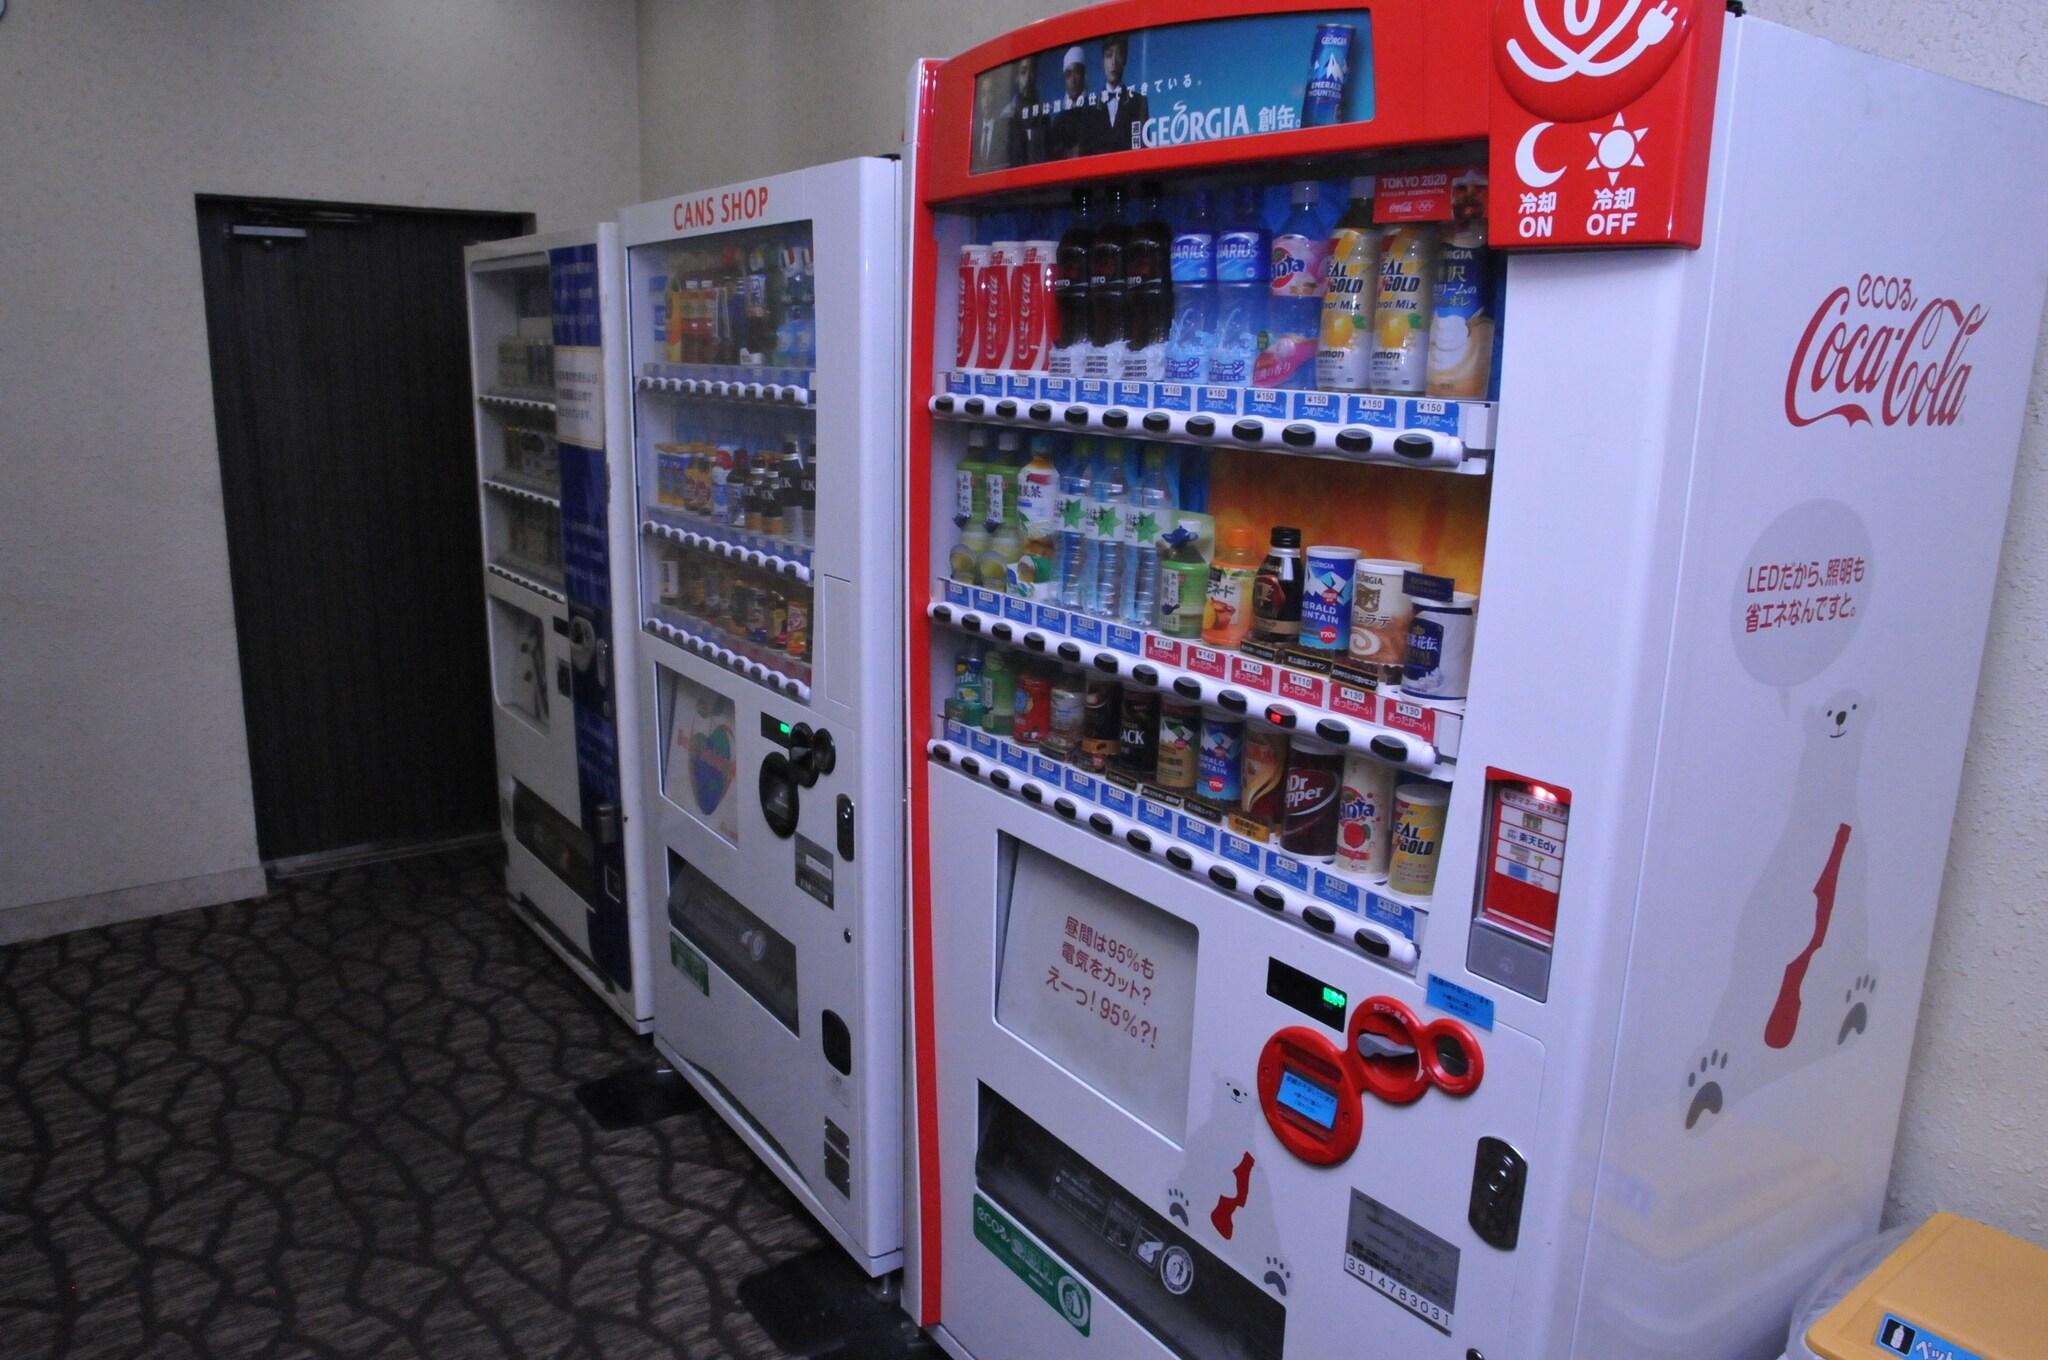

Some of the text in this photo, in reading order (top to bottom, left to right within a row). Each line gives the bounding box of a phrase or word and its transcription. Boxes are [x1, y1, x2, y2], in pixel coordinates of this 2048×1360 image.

[1141, 100, 1250, 148] GEORGIA
[1421, 174, 1447, 187] 2020
[1592, 187, 1635, 211] 冷却
[673, 186, 769, 232] CANS SHOP
[1519, 192, 1557, 214] 冷却
[1519, 216, 1553, 238] ON
[1586, 212, 1638, 236] OFF
[1419, 403, 1442, 413] ¥150
[1746, 556, 1865, 594] LEDだから、照明も
[1745, 592, 1857, 633] 省エネなんですと。
[1064, 915, 1154, 980] 昼間は95%も
[1062, 941, 1152, 1006] 電気をカット?
[1346, 1257, 1450, 1328] 3914783031
